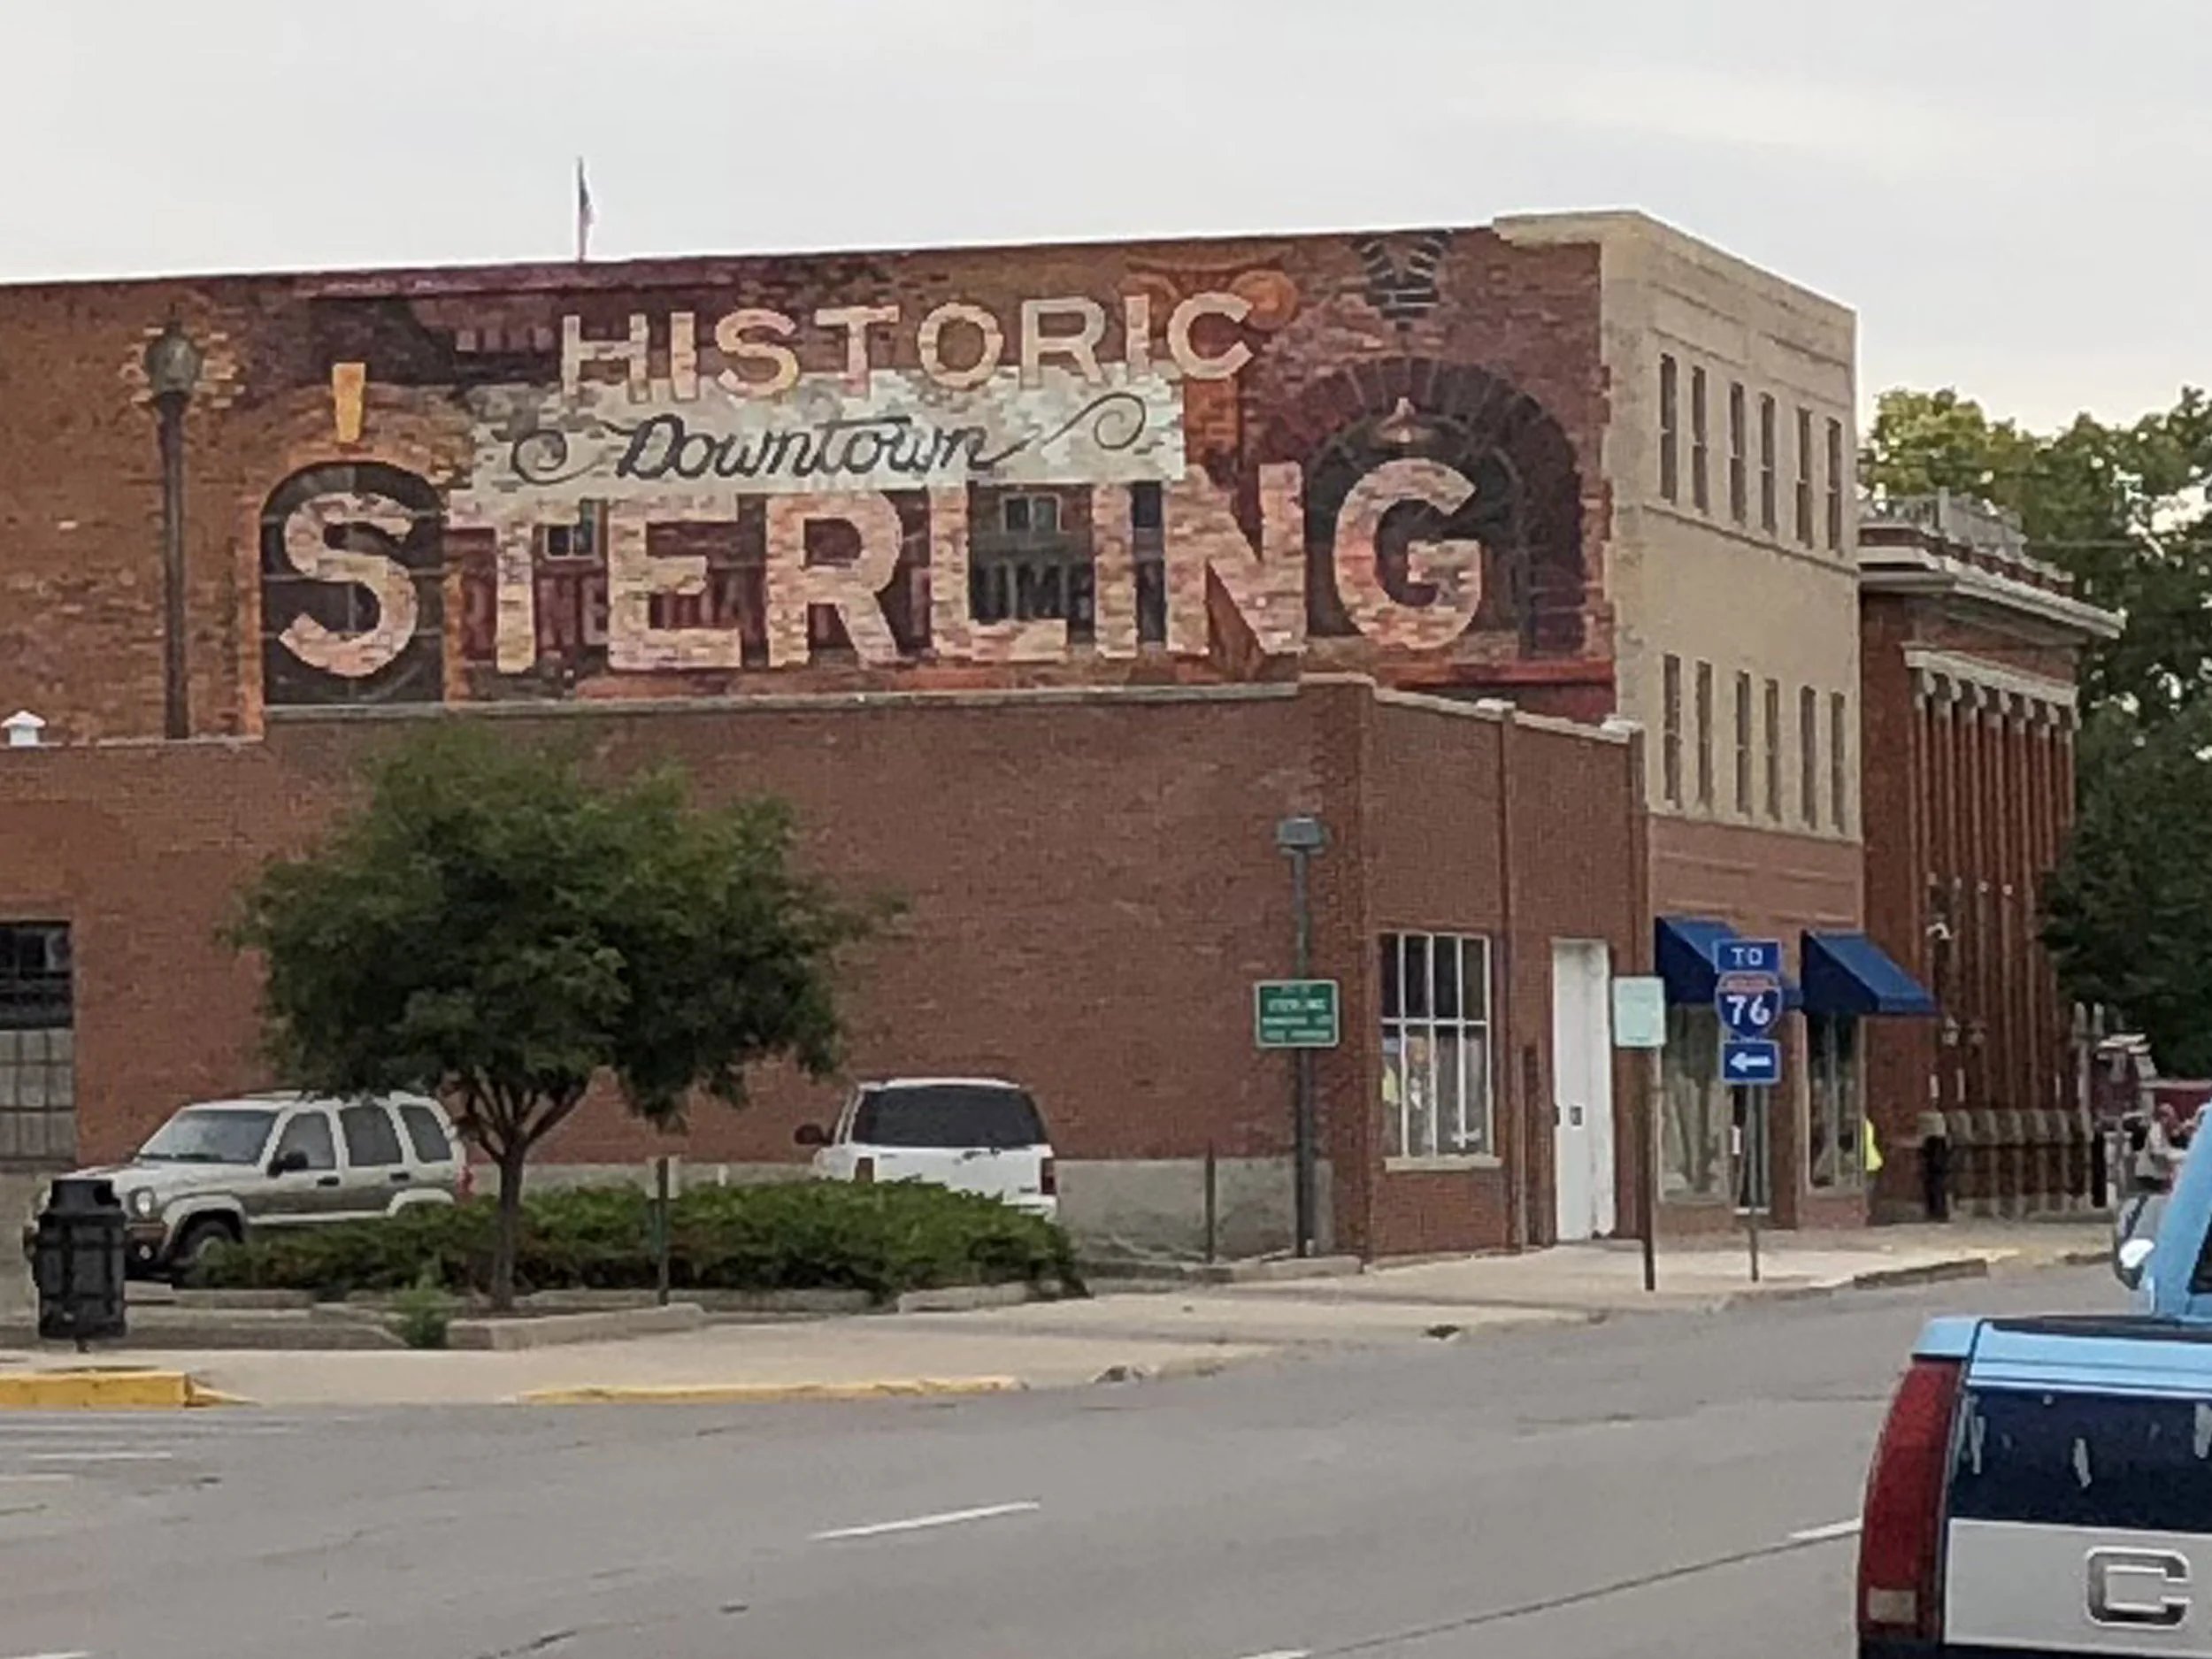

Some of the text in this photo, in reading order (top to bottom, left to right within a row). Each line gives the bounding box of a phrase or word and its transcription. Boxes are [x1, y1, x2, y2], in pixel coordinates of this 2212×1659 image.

[560, 290, 1254, 403] HISTORIC
[609, 412, 1010, 480] Downtown
[278, 455, 1485, 680] STERLING
[1730, 947, 1764, 967] TO
[1726, 994, 1770, 1025] 76
